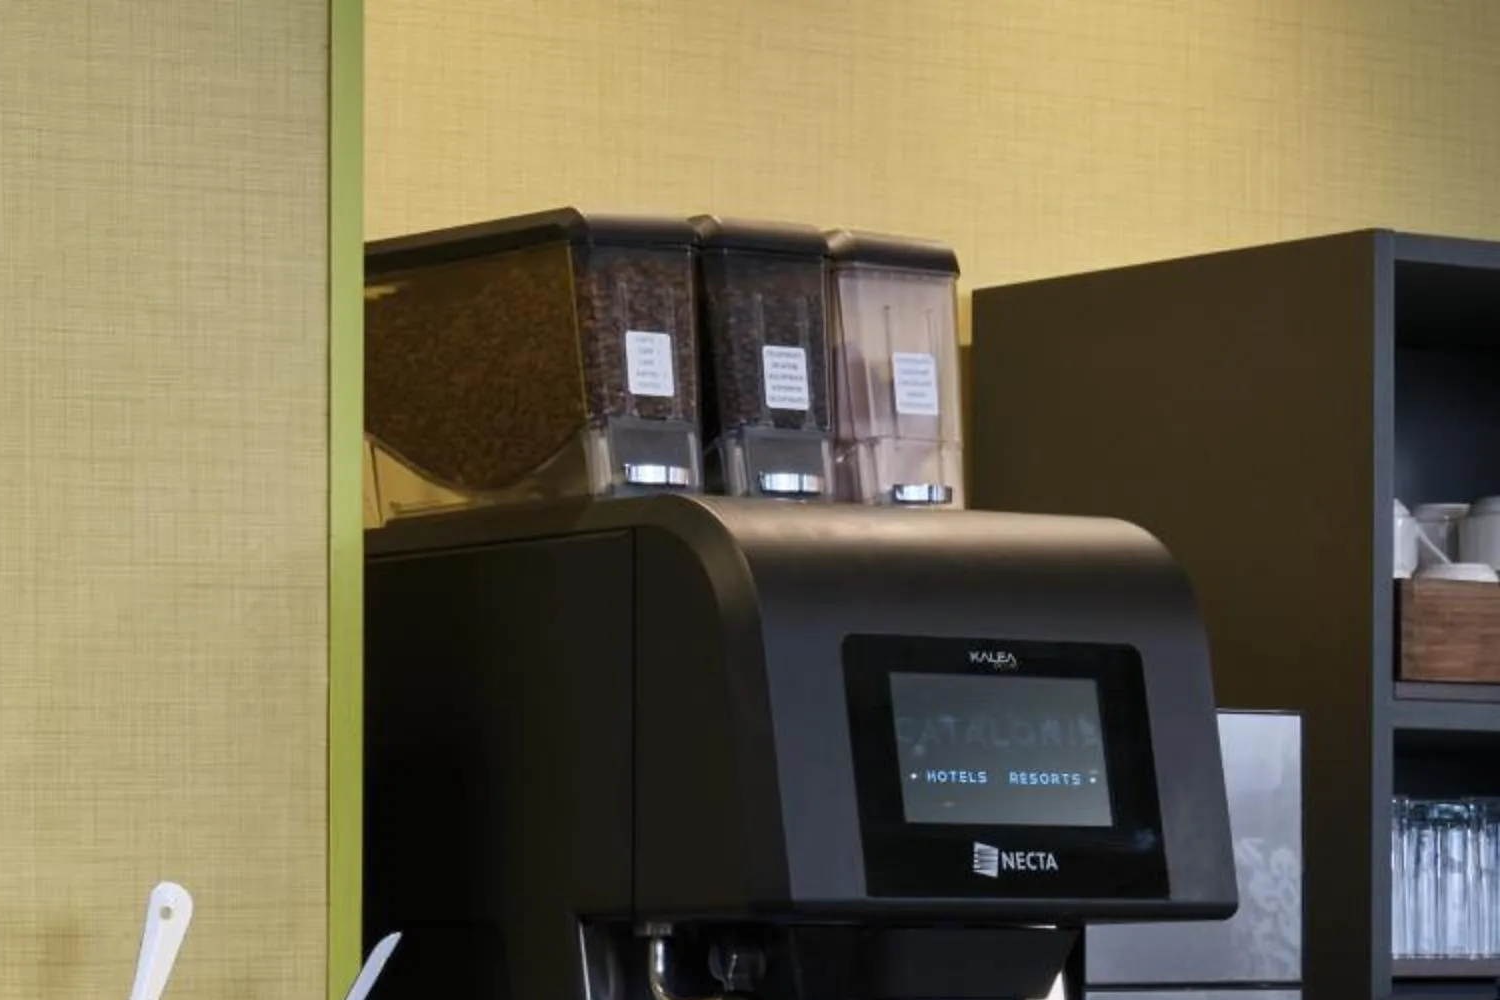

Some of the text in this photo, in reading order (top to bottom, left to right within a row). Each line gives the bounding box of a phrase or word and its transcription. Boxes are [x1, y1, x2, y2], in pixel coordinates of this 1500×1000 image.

[926, 770, 1082, 786] HOTELS RESORTS
[1001, 851, 1059, 871] NECTA
